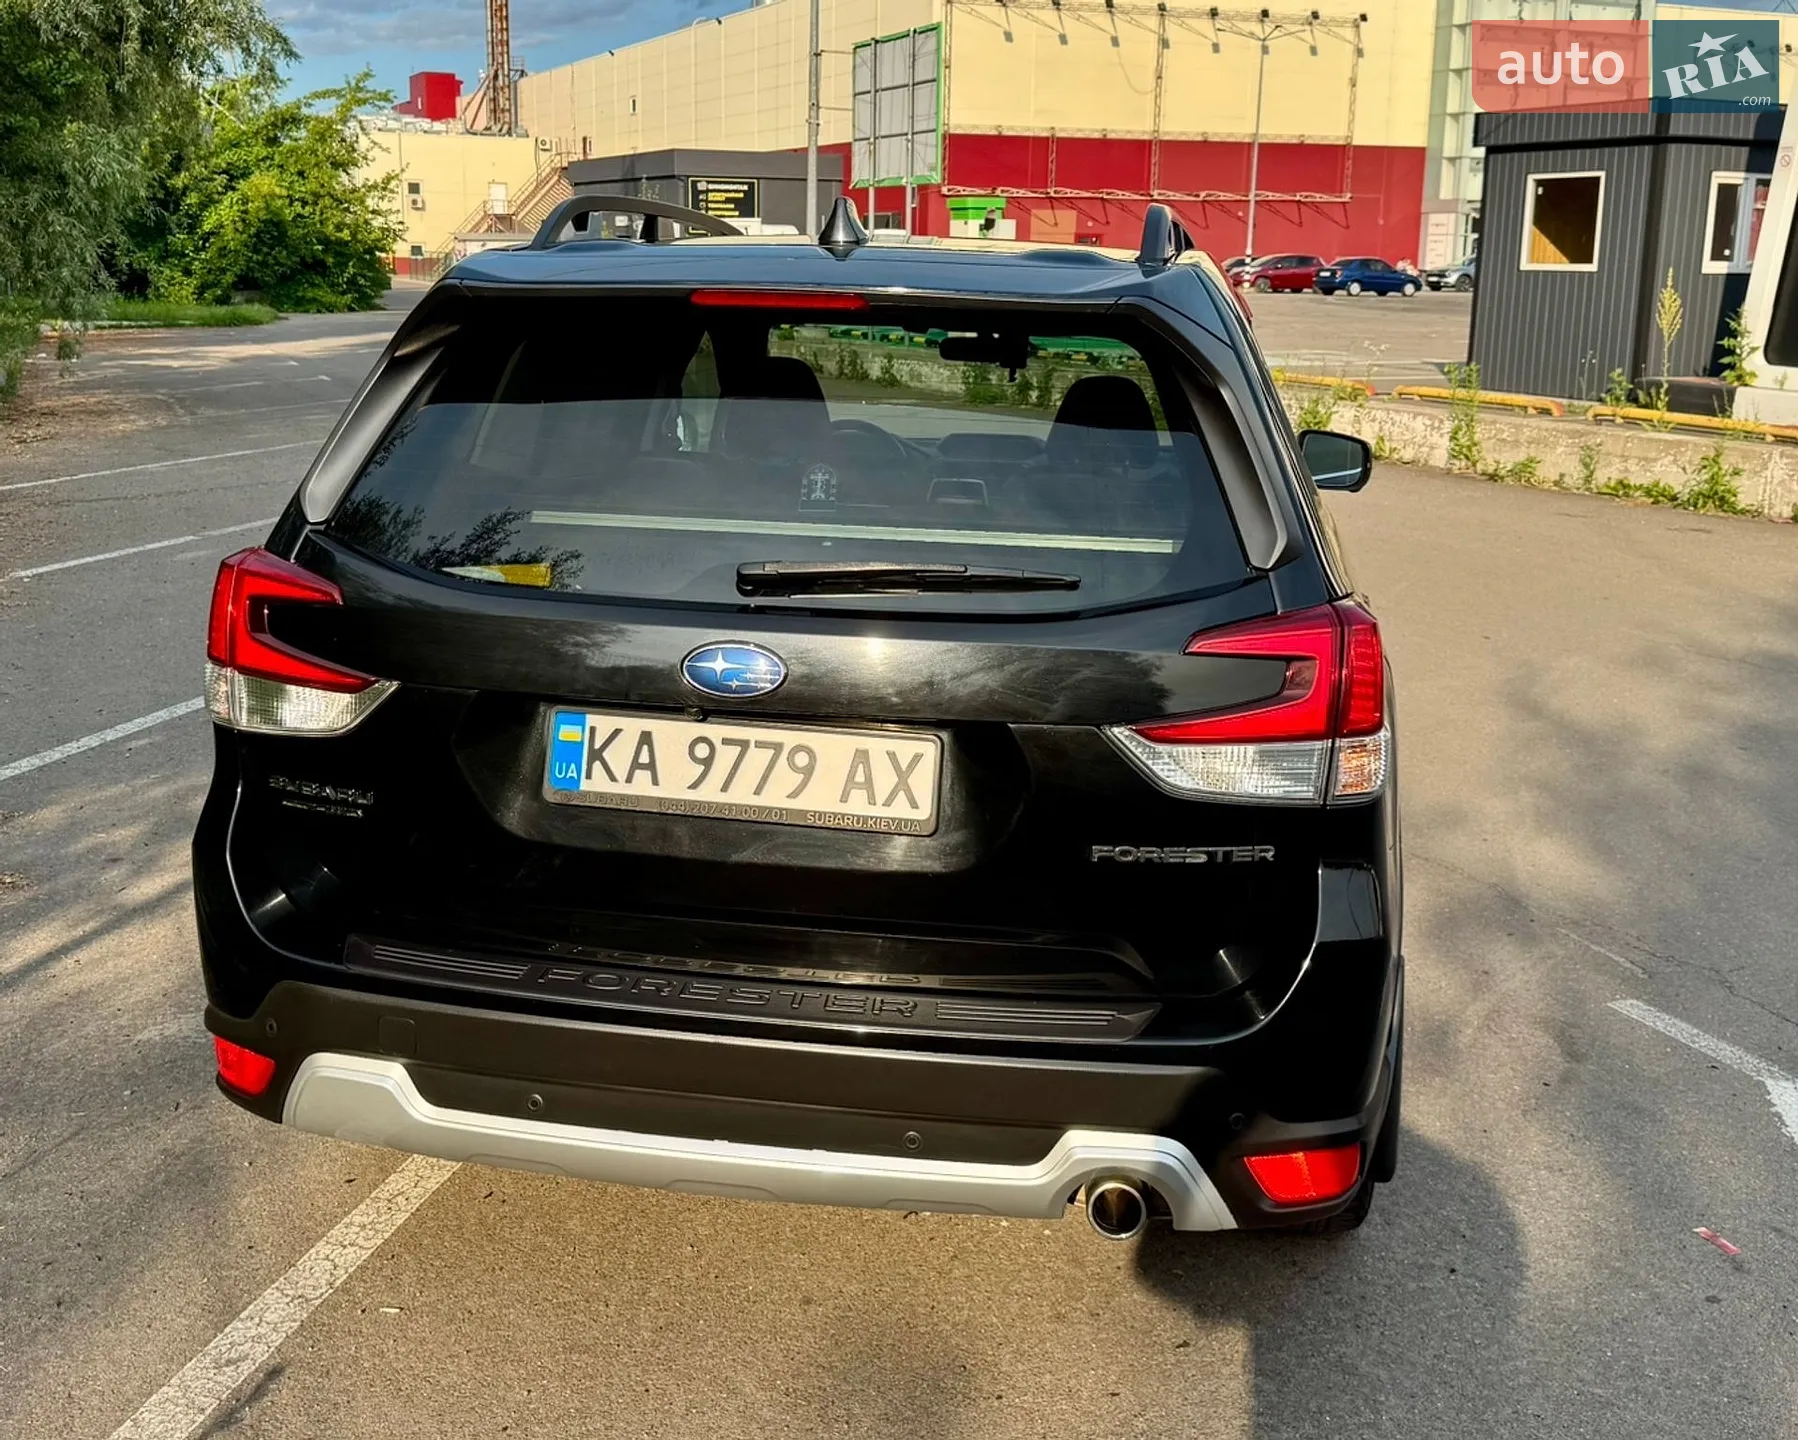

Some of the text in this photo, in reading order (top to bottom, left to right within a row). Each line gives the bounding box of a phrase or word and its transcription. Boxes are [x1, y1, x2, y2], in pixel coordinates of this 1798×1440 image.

[554, 761, 579, 780] UA
[585, 725, 925, 810] KA 9779 AX
[806, 811, 921, 832] SUBARU.KIEV.UA
[1092, 845, 1276, 864] FORESTER
[537, 965, 919, 1018] FORESTER
